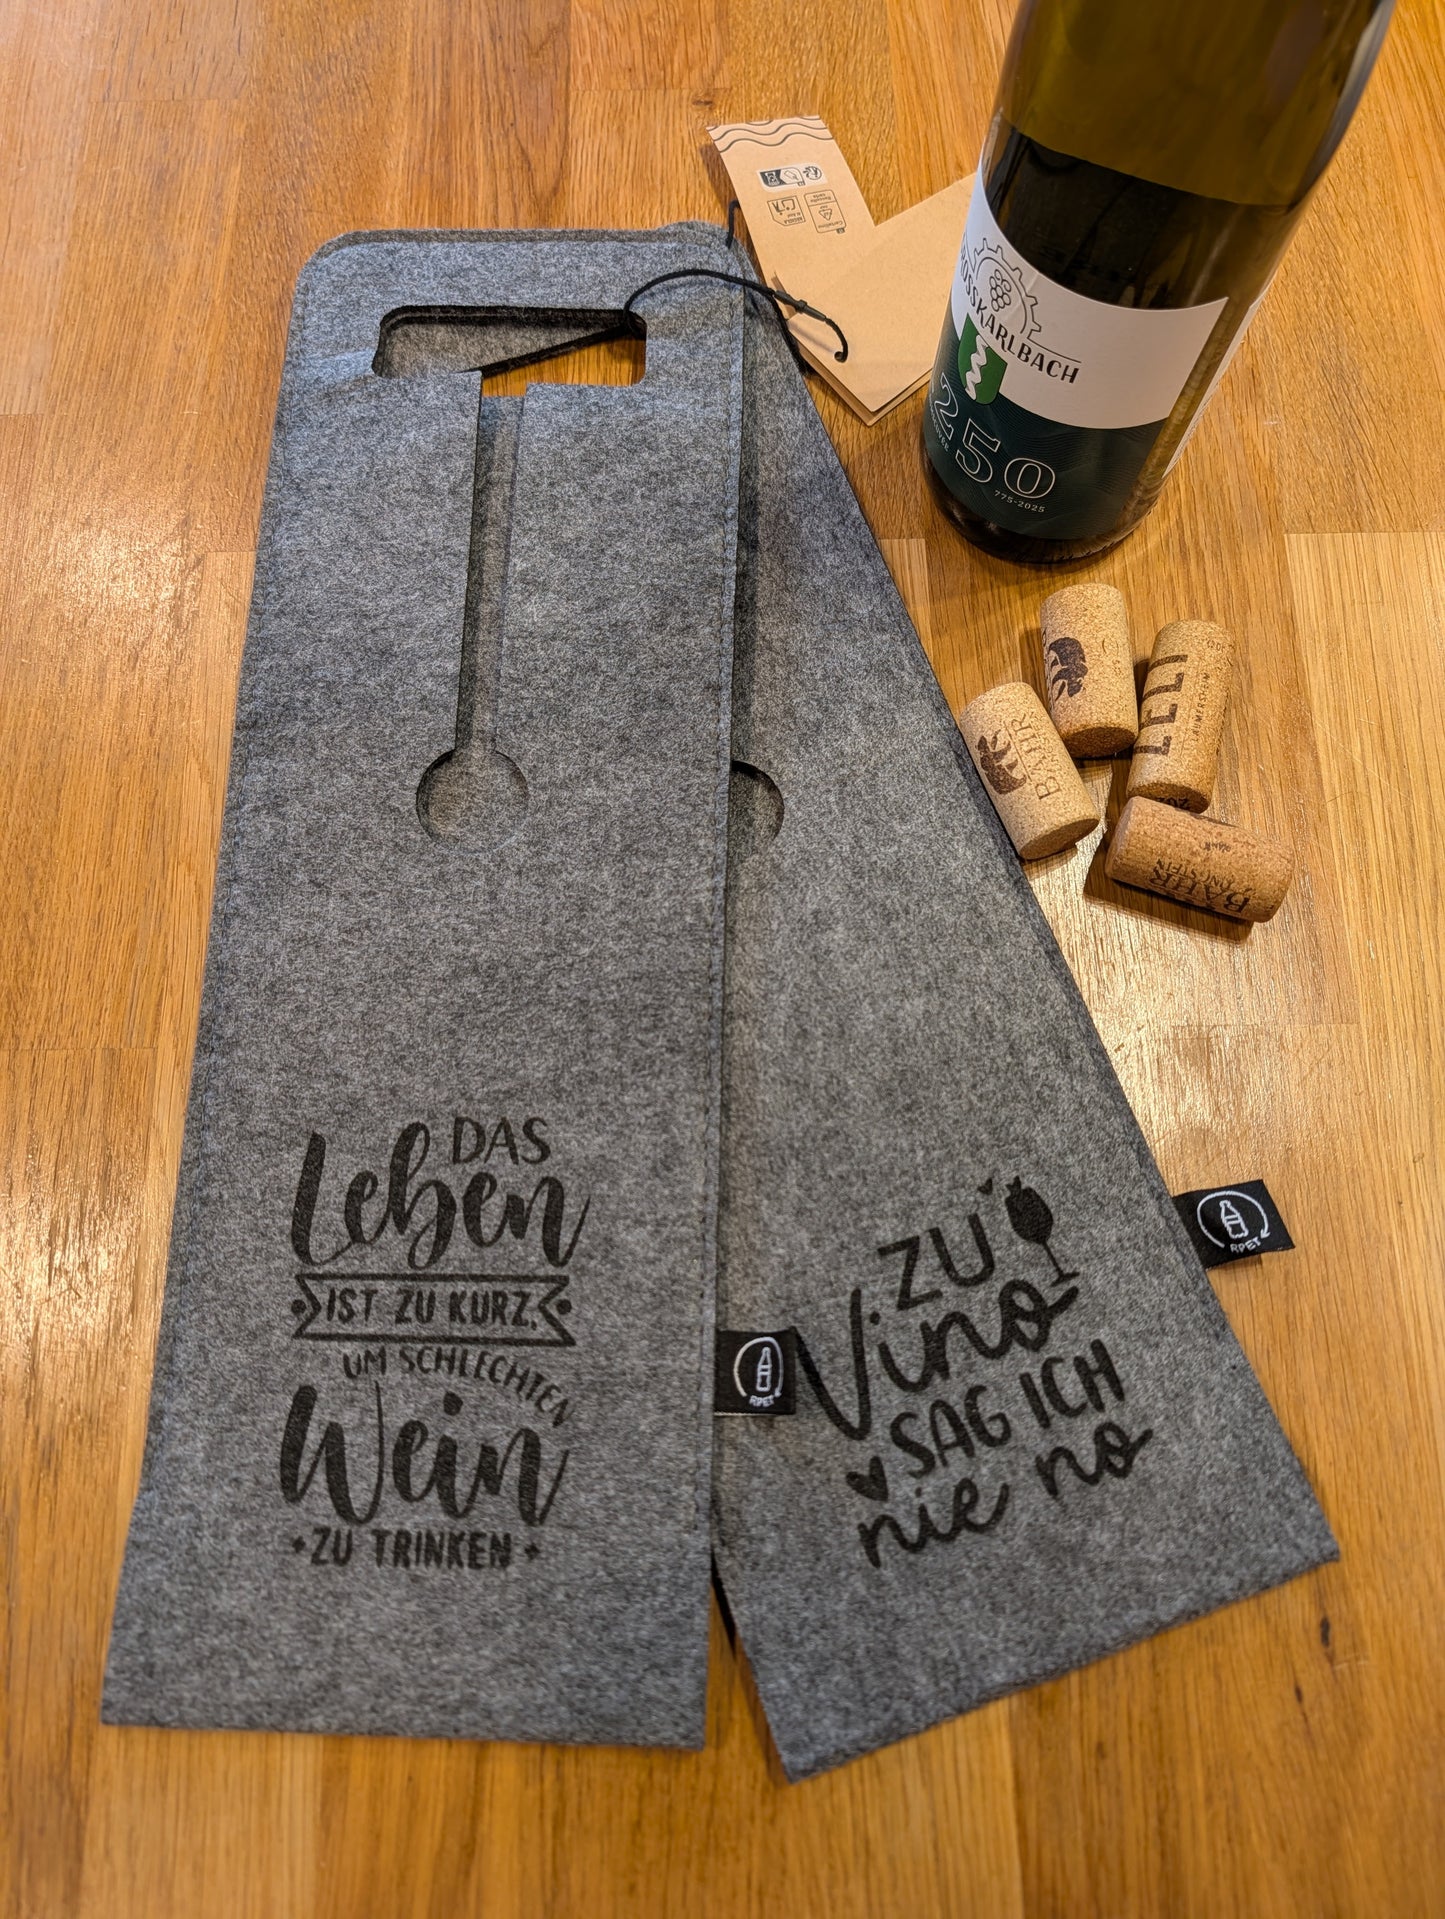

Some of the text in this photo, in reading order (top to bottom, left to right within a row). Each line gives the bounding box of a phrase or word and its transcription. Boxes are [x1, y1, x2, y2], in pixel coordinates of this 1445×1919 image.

[960, 238, 1080, 384] ROSSKARLBACH
[994, 489, 1046, 513] 775-2025
[453, 1116, 551, 1165] DAS
[291, 1121, 591, 1270] Leben
[1229, 1236, 1261, 1254] RPET
[327, 1287, 378, 1323] IST
[395, 1290, 436, 1324] ZU
[877, 1213, 995, 1312] ZU
[343, 1345, 573, 1428] UM SCHLECHTEN
[792, 1279, 1079, 1441] Vino
[890, 1338, 1126, 1478] SAG ICH
[280, 1379, 571, 1526] Wein
[857, 1421, 1154, 1568] nie no
[311, 1527, 512, 1569] ZU TRINKEN
